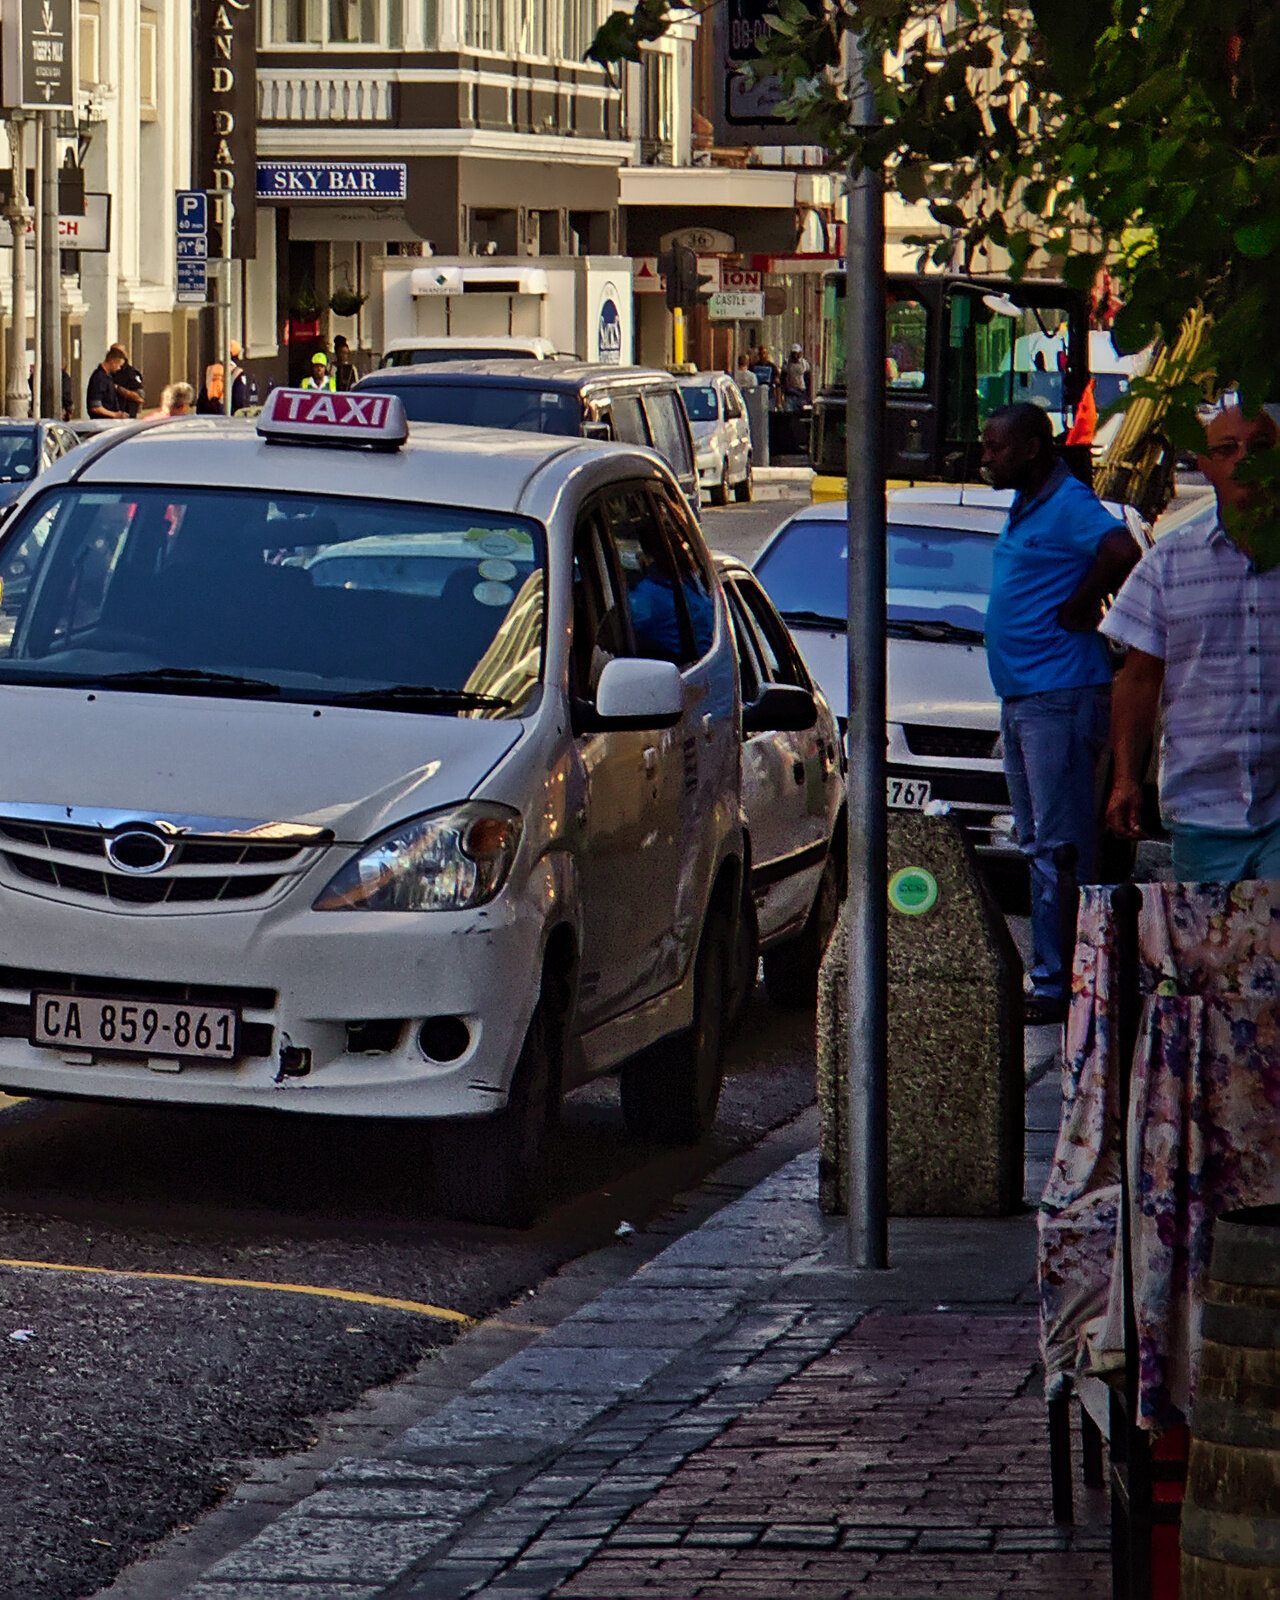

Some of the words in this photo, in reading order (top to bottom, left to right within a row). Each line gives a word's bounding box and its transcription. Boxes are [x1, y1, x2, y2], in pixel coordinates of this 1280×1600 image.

[274, 171, 323, 190] SKY
[328, 171, 376, 190] BAR
[183, 197, 198, 216] P
[283, 392, 384, 426] TAXI
[44, 1000, 82, 1039] CA
[99, 1004, 232, 1051] 859-861
